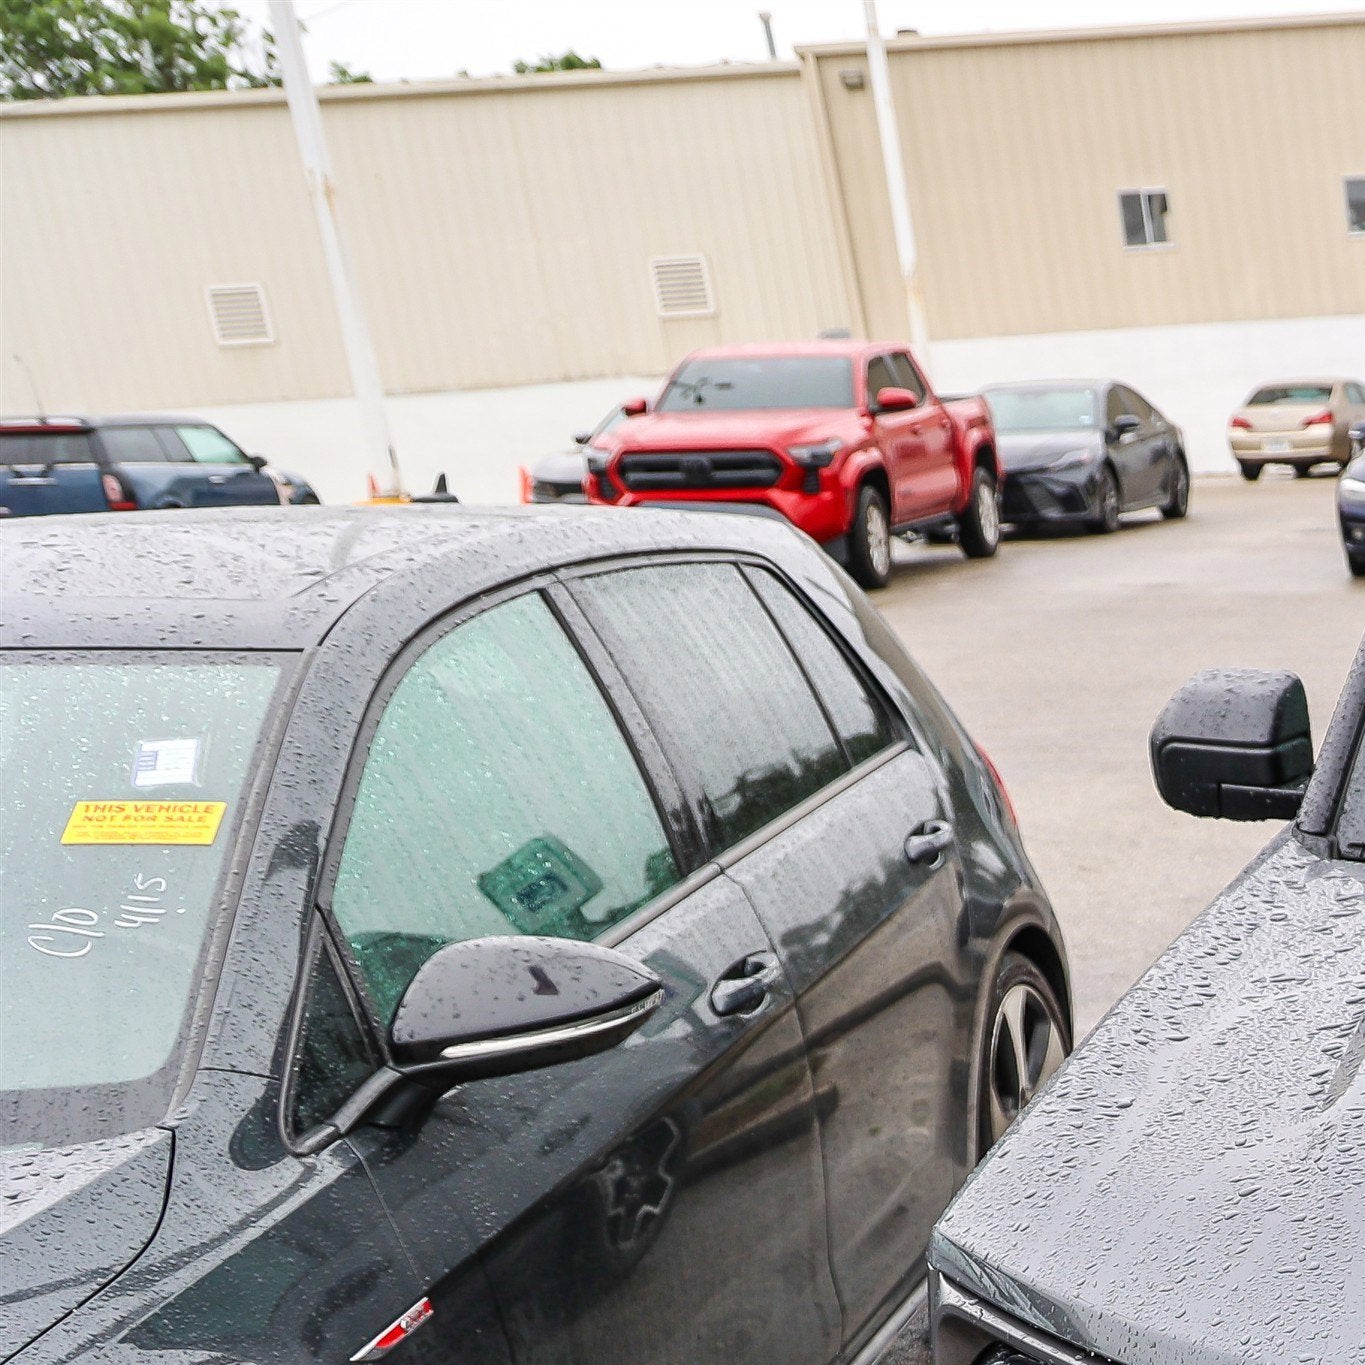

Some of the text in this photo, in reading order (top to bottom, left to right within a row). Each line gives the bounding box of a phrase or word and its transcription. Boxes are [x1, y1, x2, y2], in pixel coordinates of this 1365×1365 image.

[84, 804, 217, 814] THIS VEHICLE
[164, 815, 207, 823] SALE
